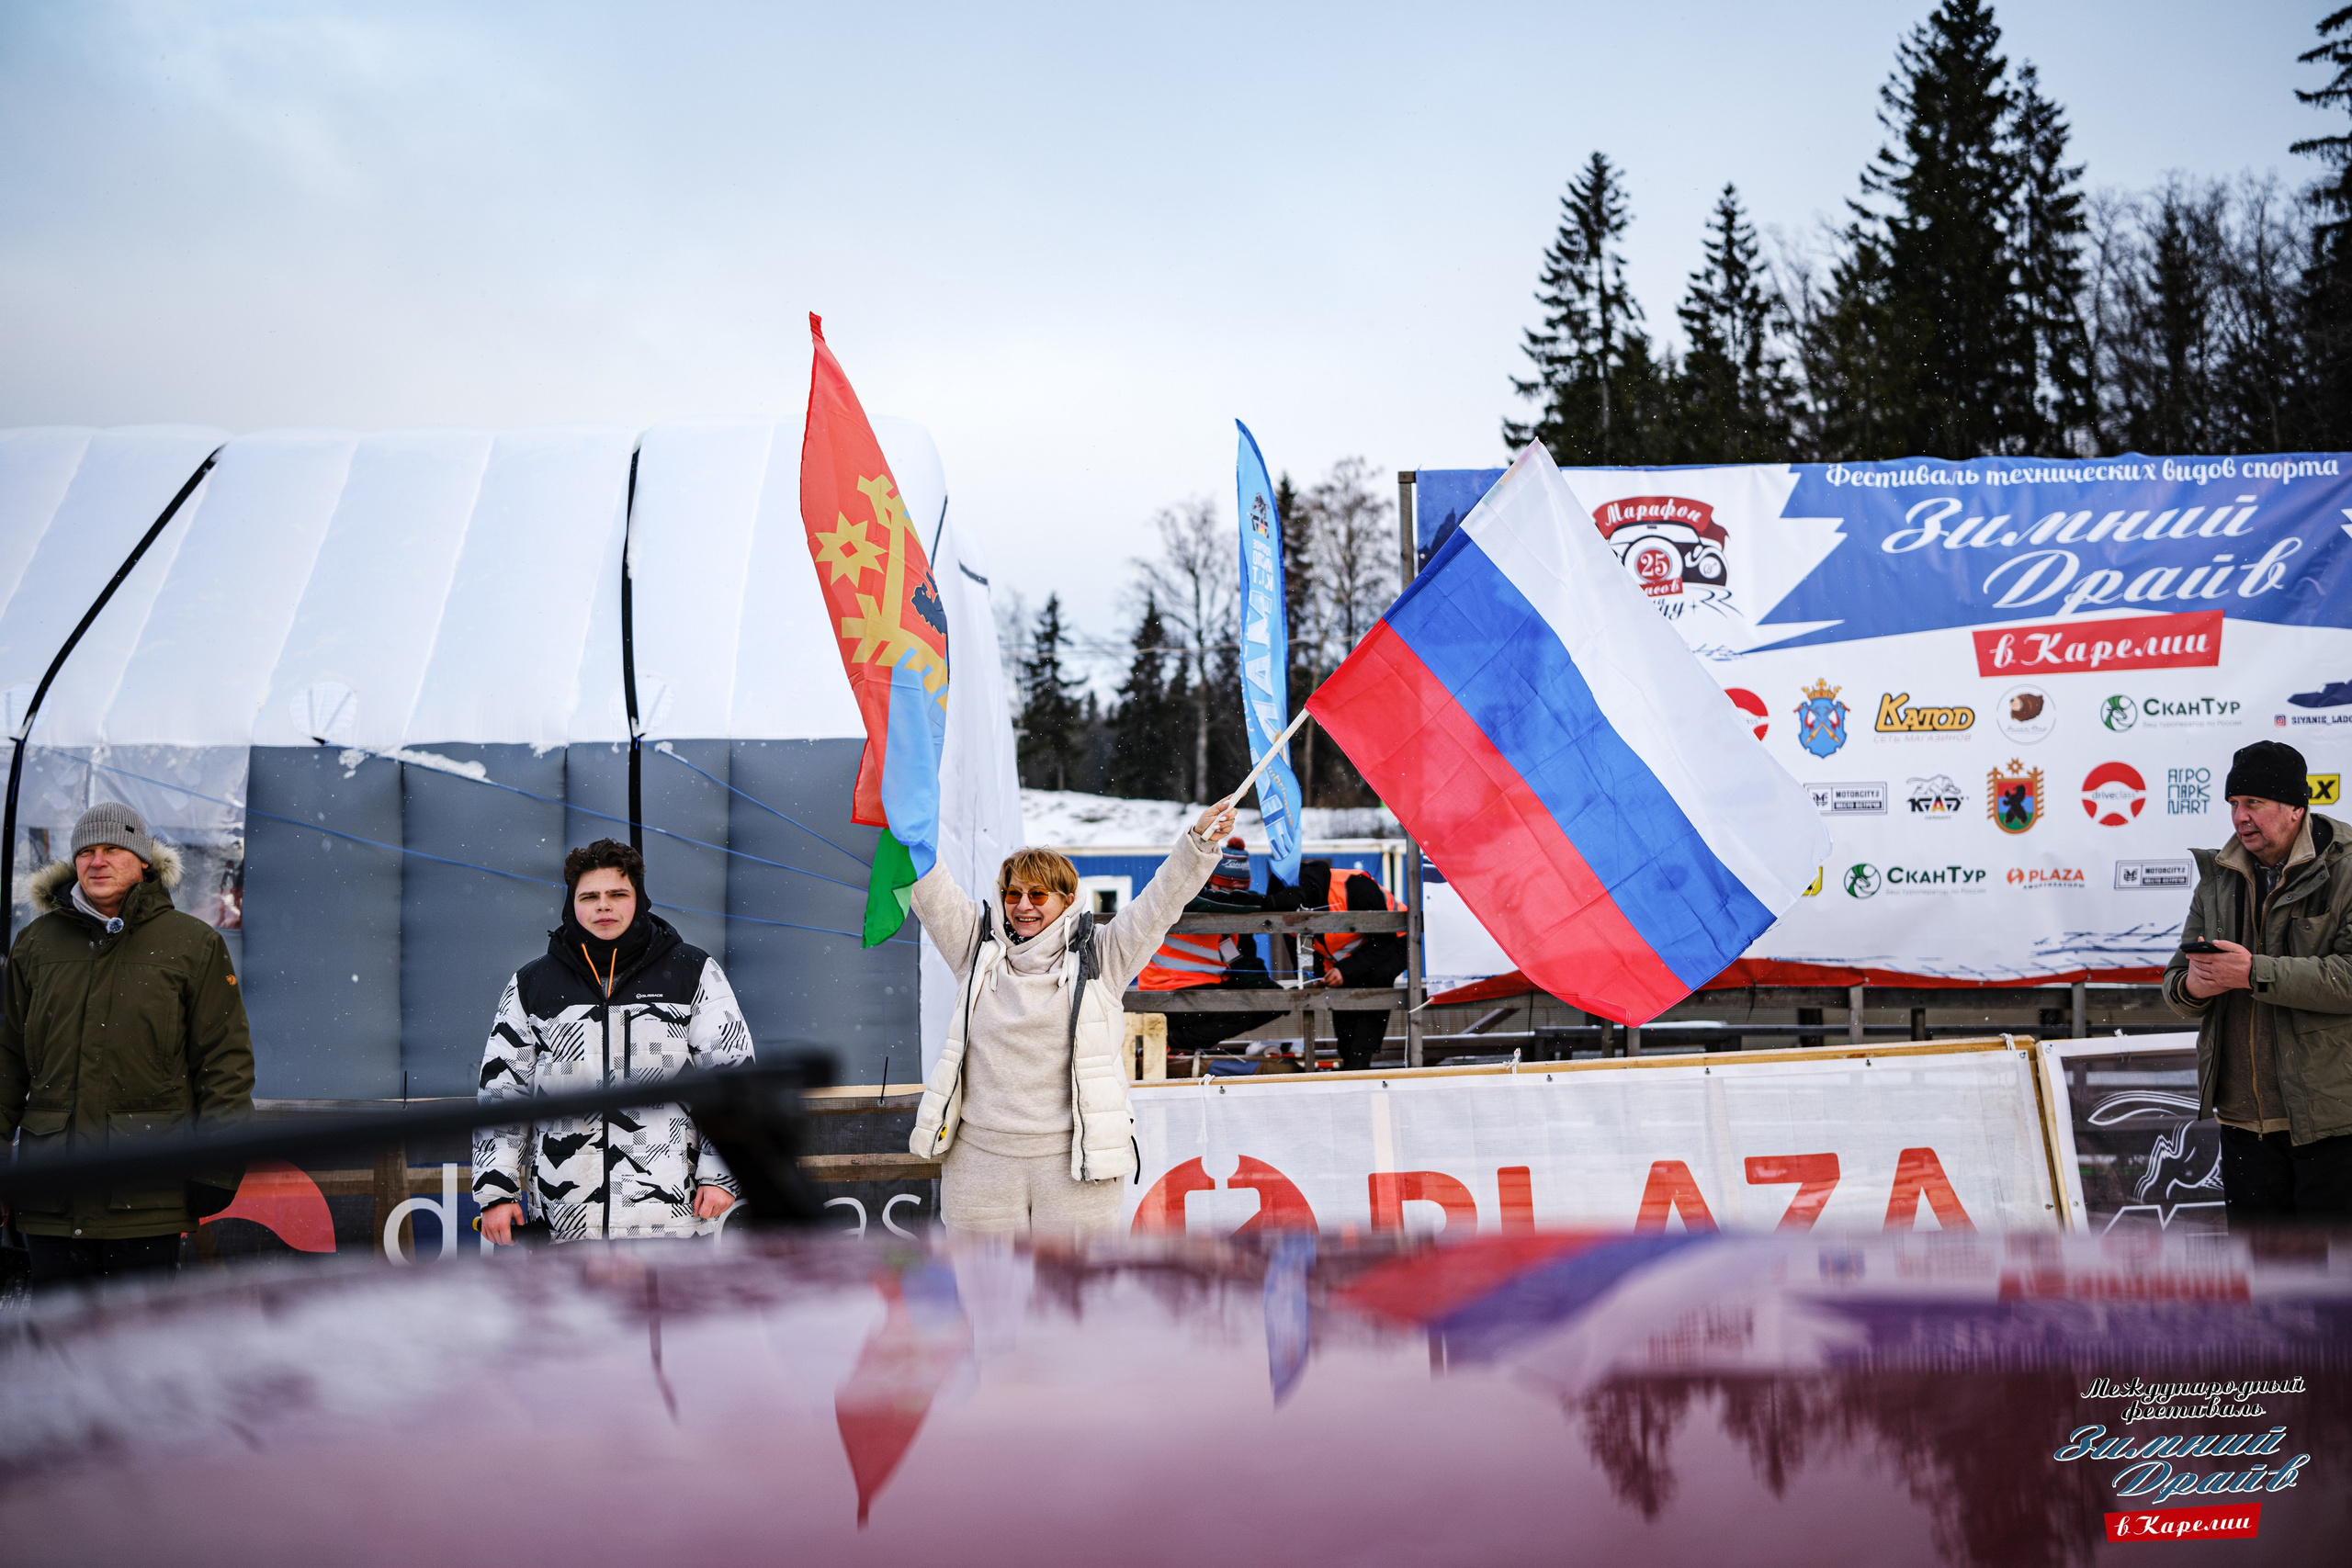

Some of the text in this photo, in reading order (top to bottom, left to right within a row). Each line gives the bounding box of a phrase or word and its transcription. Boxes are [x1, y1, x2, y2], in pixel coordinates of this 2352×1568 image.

[1826, 457, 2340, 488] Фестиваль технических видов спорта
[1604, 498, 1702, 527] Марафон
[1882, 494, 2258, 553] Зимний
[1640, 552, 1668, 577] 25
[1983, 536, 2302, 616] Драйв
[1643, 578, 1680, 596] асов
[1989, 632, 2211, 668] в Карелии
[1874, 733, 1972, 743] СЕТЬ МАГАЗИНОВ
[2168, 767, 2211, 784] АГРО
[2168, 784, 2211, 798] ПАРК
[2029, 868, 2085, 882] PLAZA
